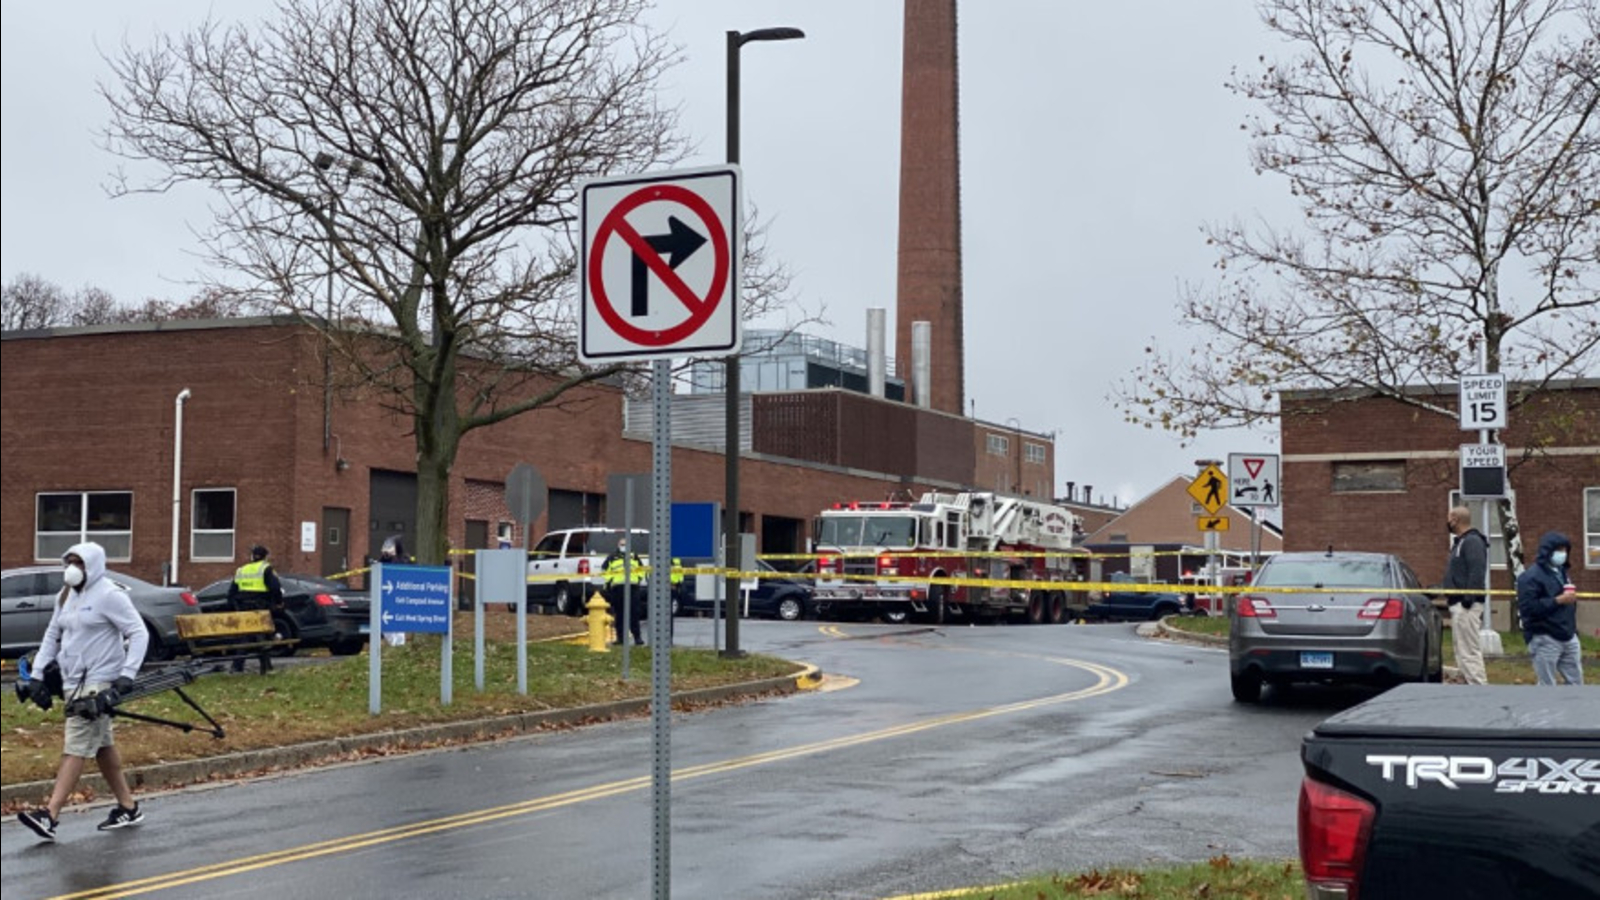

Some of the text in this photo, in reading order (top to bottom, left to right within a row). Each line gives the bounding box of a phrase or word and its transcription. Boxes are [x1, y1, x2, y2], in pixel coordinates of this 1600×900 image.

[1463, 380, 1502, 390] SPEED
[1467, 391, 1497, 400] LIMIT
[1470, 402, 1497, 422] 15
[1468, 447, 1497, 455] YOUR
[1466, 457, 1499, 466] SPEED
[1234, 478, 1250, 486] HERE
[395, 581, 448, 594] Additional Parking
[1366, 755, 1496, 789] TRD
